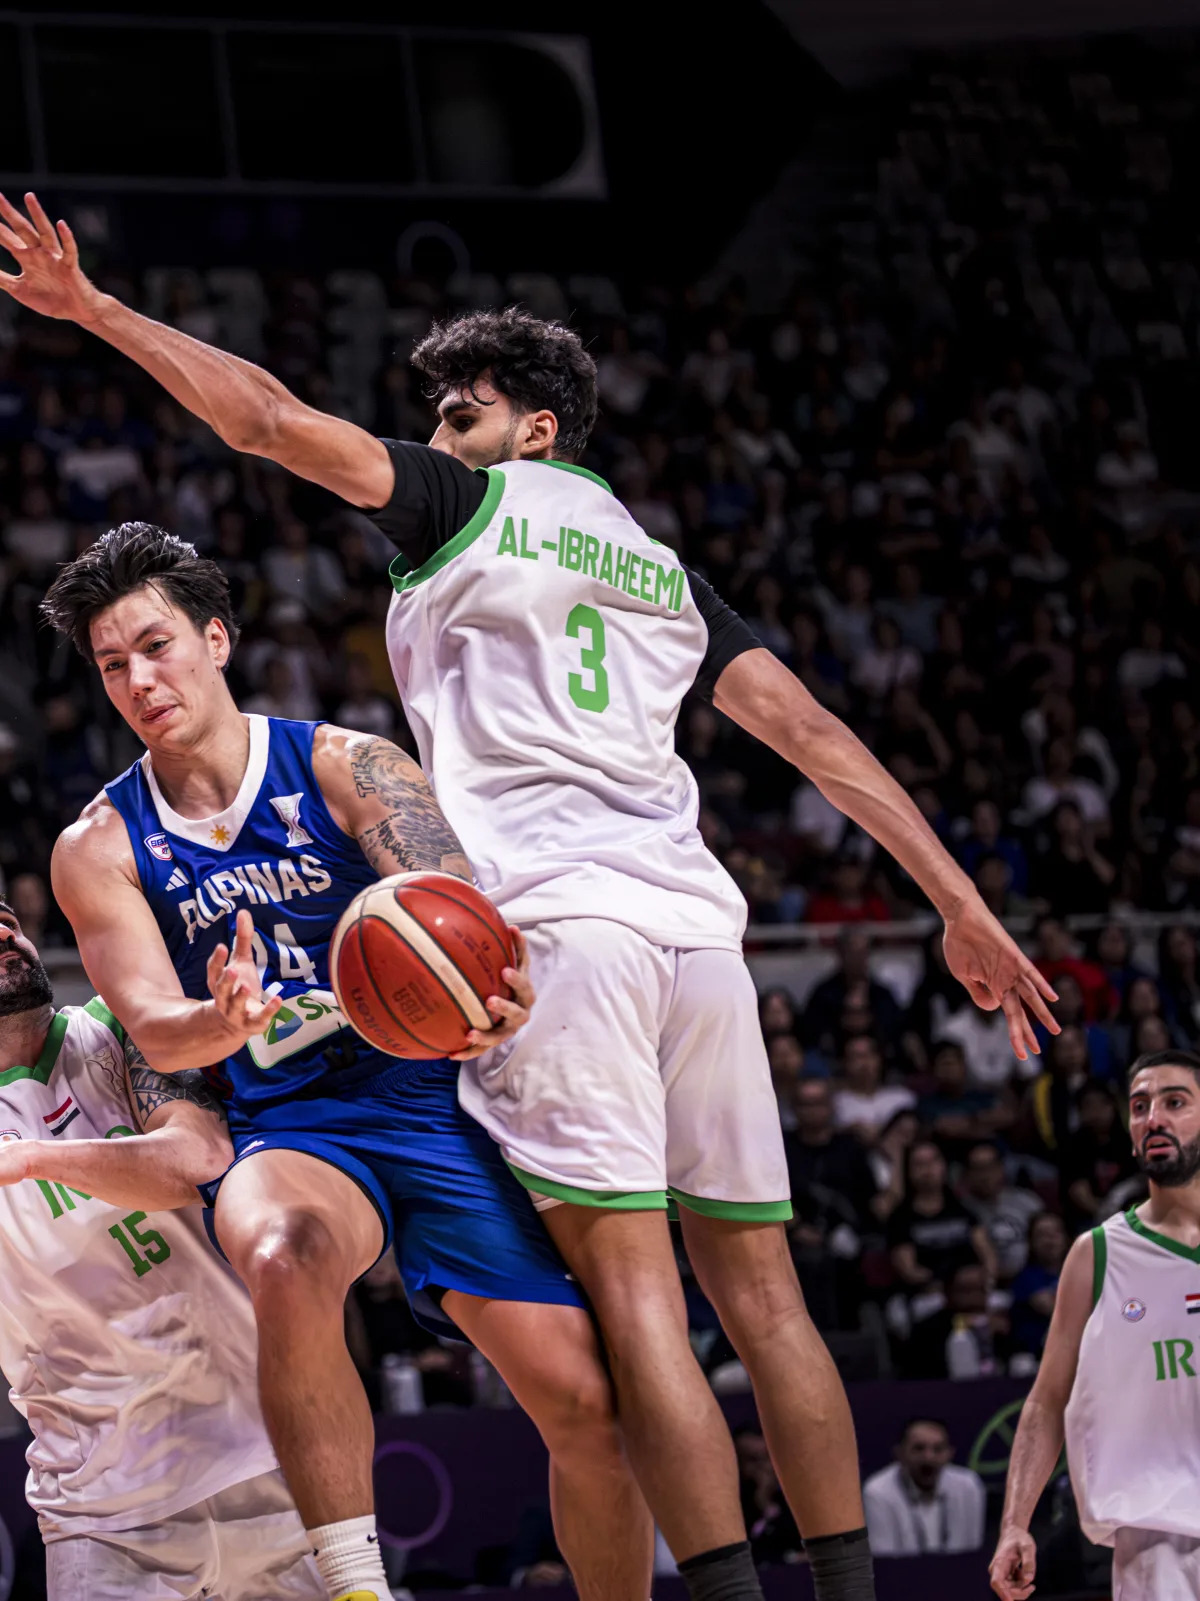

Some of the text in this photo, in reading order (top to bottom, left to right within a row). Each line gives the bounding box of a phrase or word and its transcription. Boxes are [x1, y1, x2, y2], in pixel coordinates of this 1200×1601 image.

[497, 516, 686, 612] AL-IBRAHEEMI
[565, 602, 610, 713] 3
[178, 854, 333, 945] PILIPINAS
[108, 1211, 171, 1277] 15
